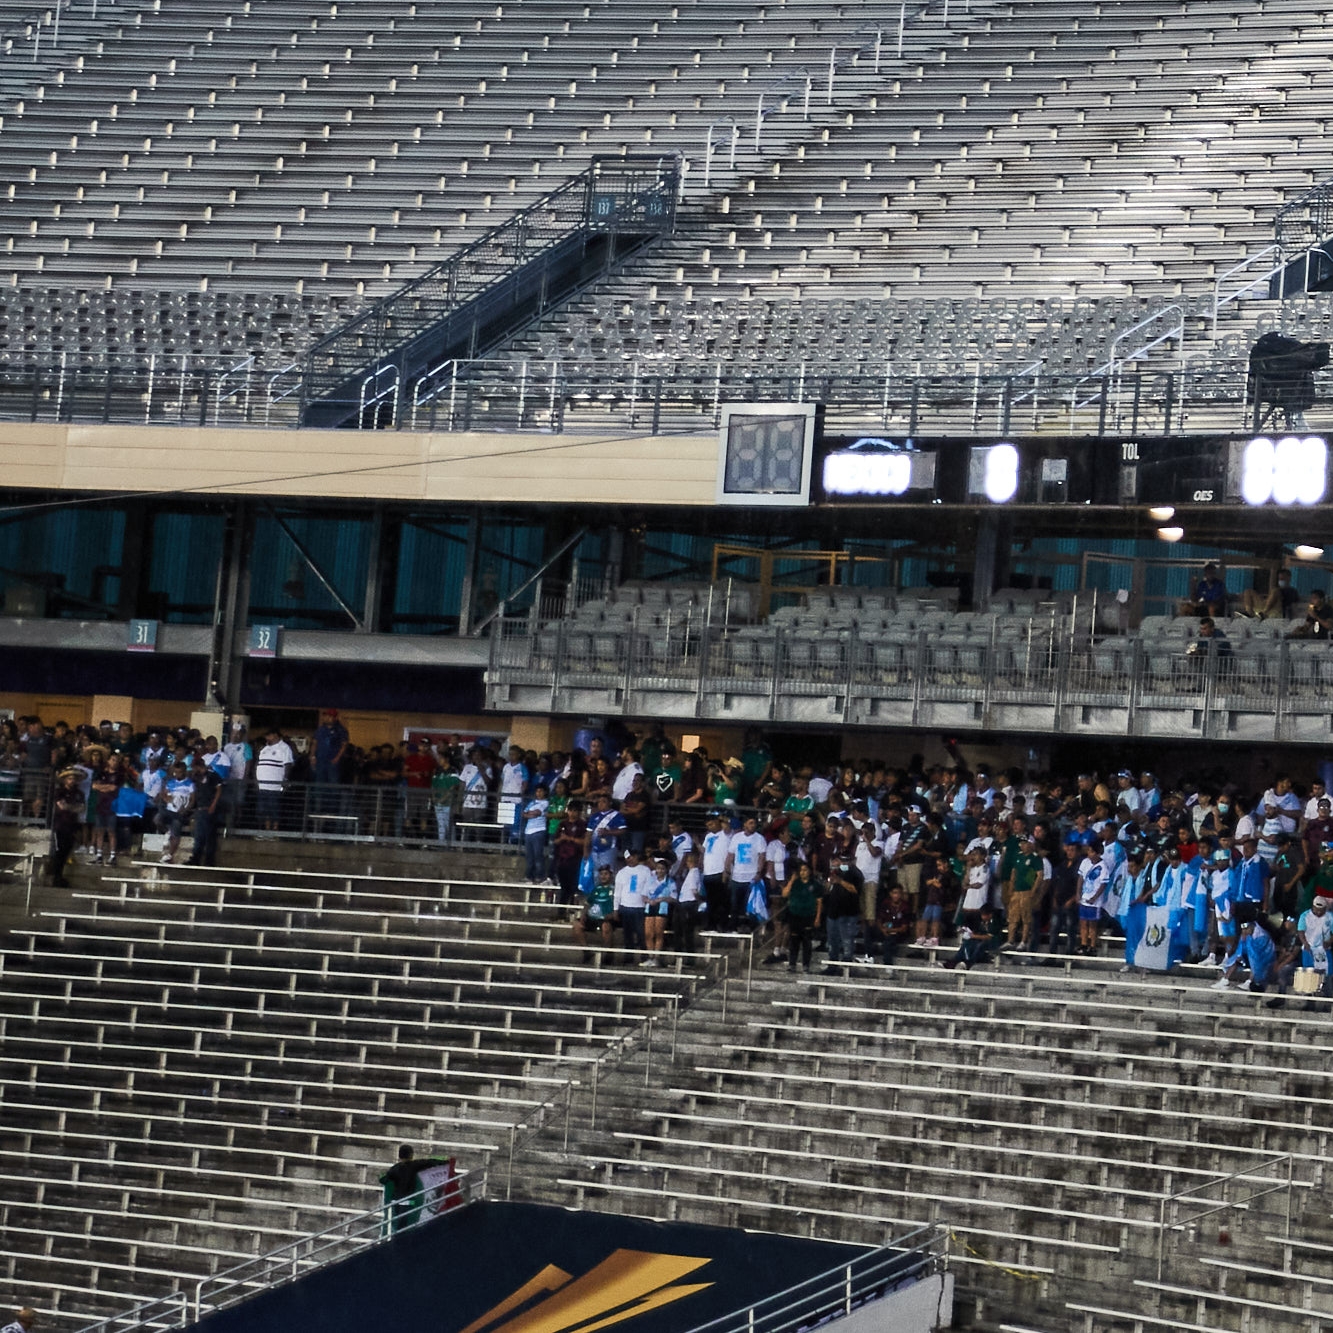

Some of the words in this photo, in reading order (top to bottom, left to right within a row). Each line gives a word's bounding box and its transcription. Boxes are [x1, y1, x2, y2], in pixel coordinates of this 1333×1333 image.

[1122, 443, 1140, 460] TOL
[136, 625, 148, 644] 31
[258, 631, 270, 649] 32
[738, 843, 752, 864] E
